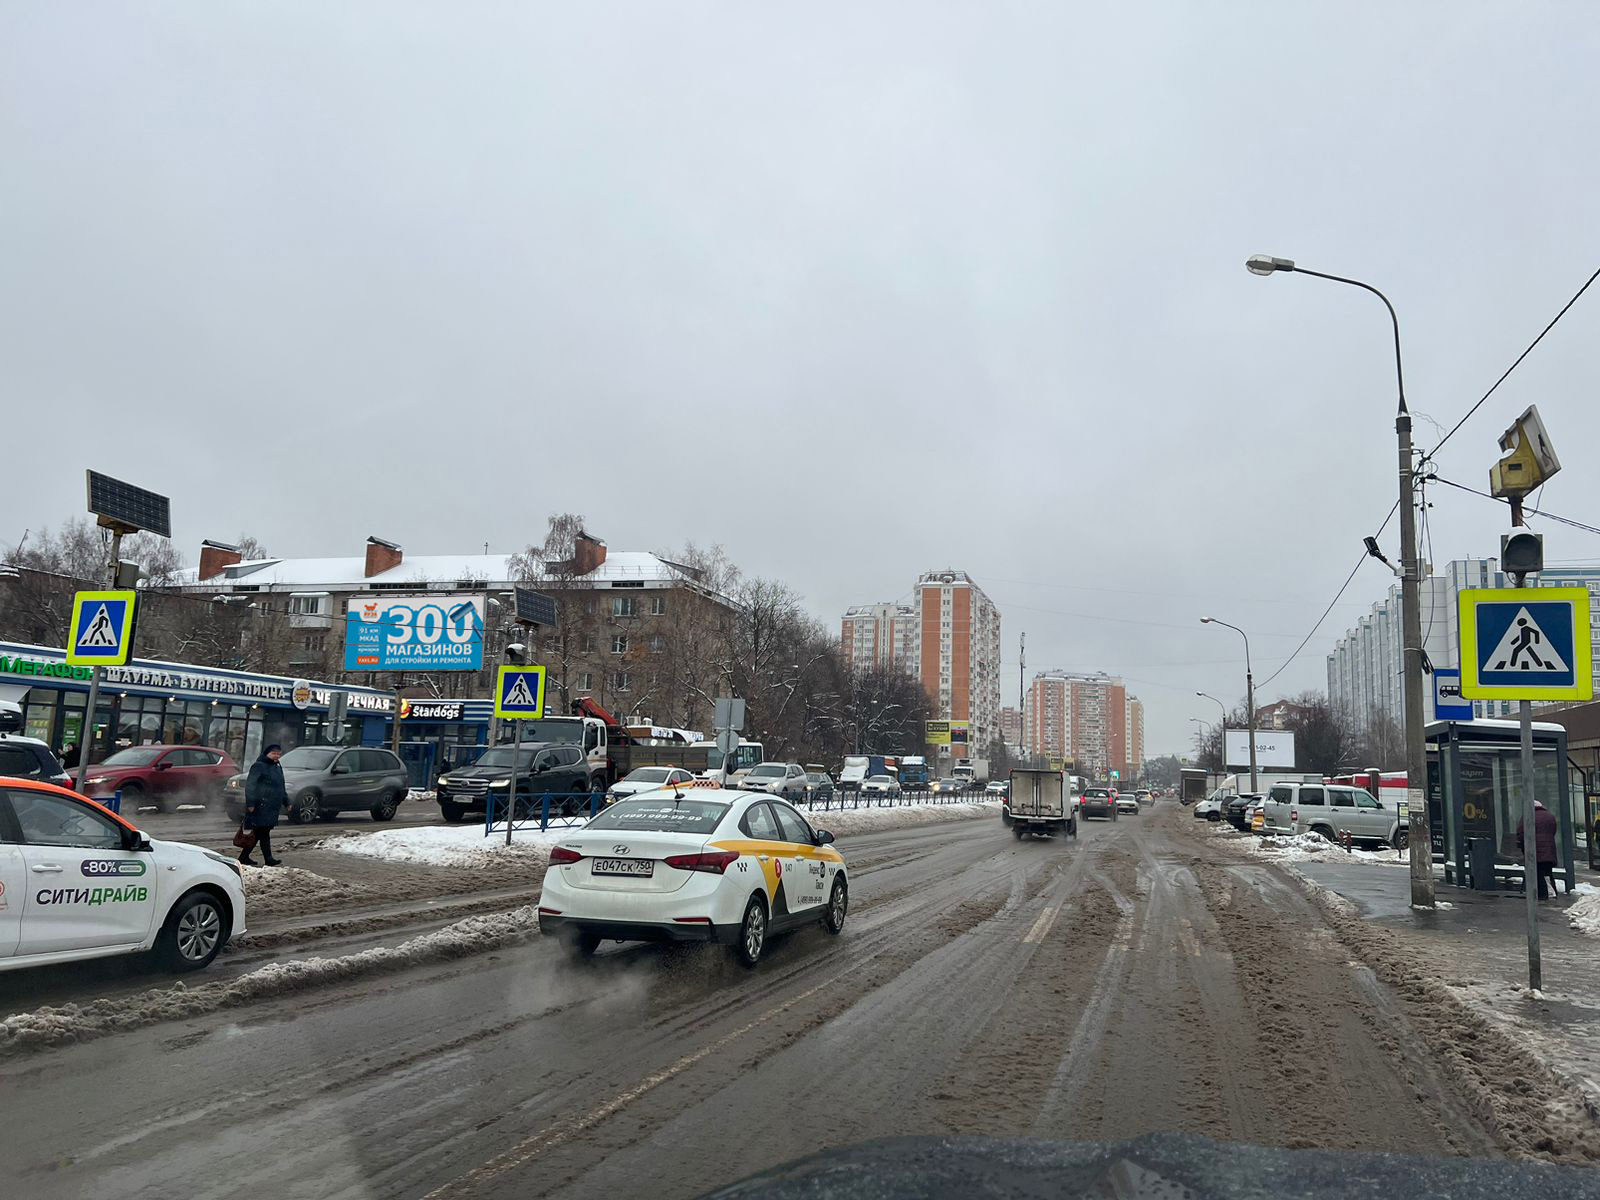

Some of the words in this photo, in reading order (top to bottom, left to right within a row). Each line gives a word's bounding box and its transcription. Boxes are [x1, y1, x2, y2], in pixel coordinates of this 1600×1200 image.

[387, 606, 473, 644] 300
[386, 644, 472, 655] МАГАЗИНОВ
[400, 656, 432, 664] СТРОЙКИ
[106, 667, 172, 687] ШАУРМА
[180, 673, 237, 694] БУРГЕРЫ
[243, 684, 287, 700] ПИЦЦА
[316, 691, 390, 711] ЧЕРЕЧНАЯ
[412, 705, 460, 719] Stardogs
[83, 861, 117, 873] -80%
[36, 884, 148, 906] СИТИДРАЙВ
